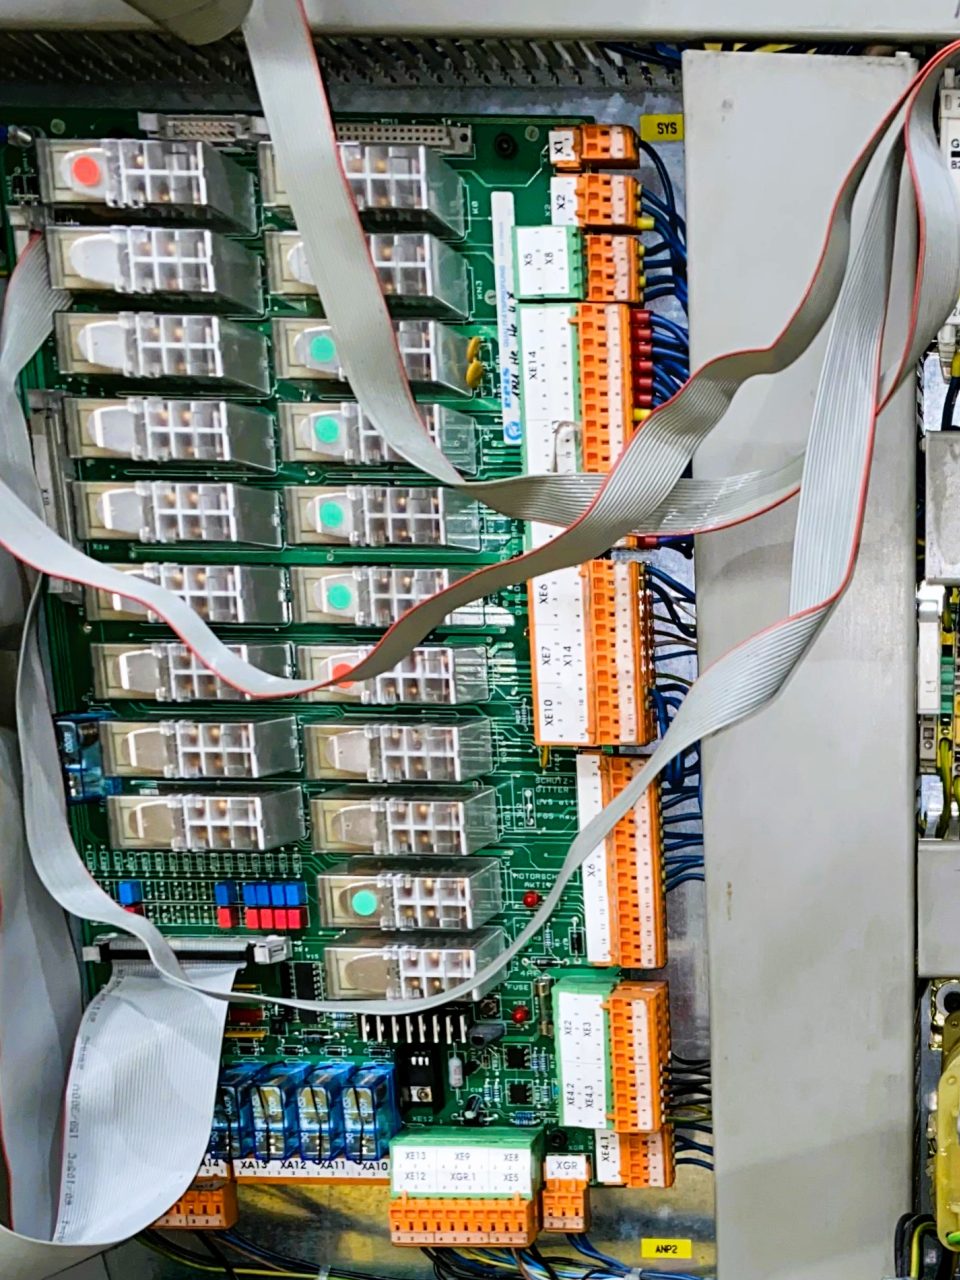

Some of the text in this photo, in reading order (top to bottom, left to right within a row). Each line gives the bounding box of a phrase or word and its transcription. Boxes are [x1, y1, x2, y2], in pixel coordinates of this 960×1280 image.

[656, 122, 678, 135] SYS
[553, 141, 564, 155] X1
[557, 194, 566, 210] X2
[523, 253, 533, 266] X5
[544, 252, 554, 265] X8
[527, 350, 538, 381] XE14
[538, 583, 549, 606] XE6
[541, 646, 552, 667] XE7
[562, 645, 573, 668] X14
[543, 698, 554, 727] XE10
[535, 777, 573, 785] SCHUTZ-
[536, 786, 569, 794] GITTER
[586, 863, 596, 878] X6
[507, 983, 529, 992] FUSE
[564, 1019, 573, 1036] XE2
[583, 1021, 592, 1038] XE3
[566, 1082, 576, 1107] XE4.2
[585, 1084, 595, 1109] XE4.3
[600, 1135, 610, 1163] XE4.1
[404, 1152, 426, 1162] XE13
[454, 1152, 471, 1162] XE9
[503, 1153, 520, 1163] XE8
[240, 1160, 268, 1170] XA13
[280, 1161, 307, 1170] XA12
[319, 1160, 346, 1170] XA11
[362, 1161, 389, 1171] XA10
[555, 1160, 578, 1171] XGR
[404, 1171, 426, 1182] XE12
[503, 1172, 520, 1183] XE5
